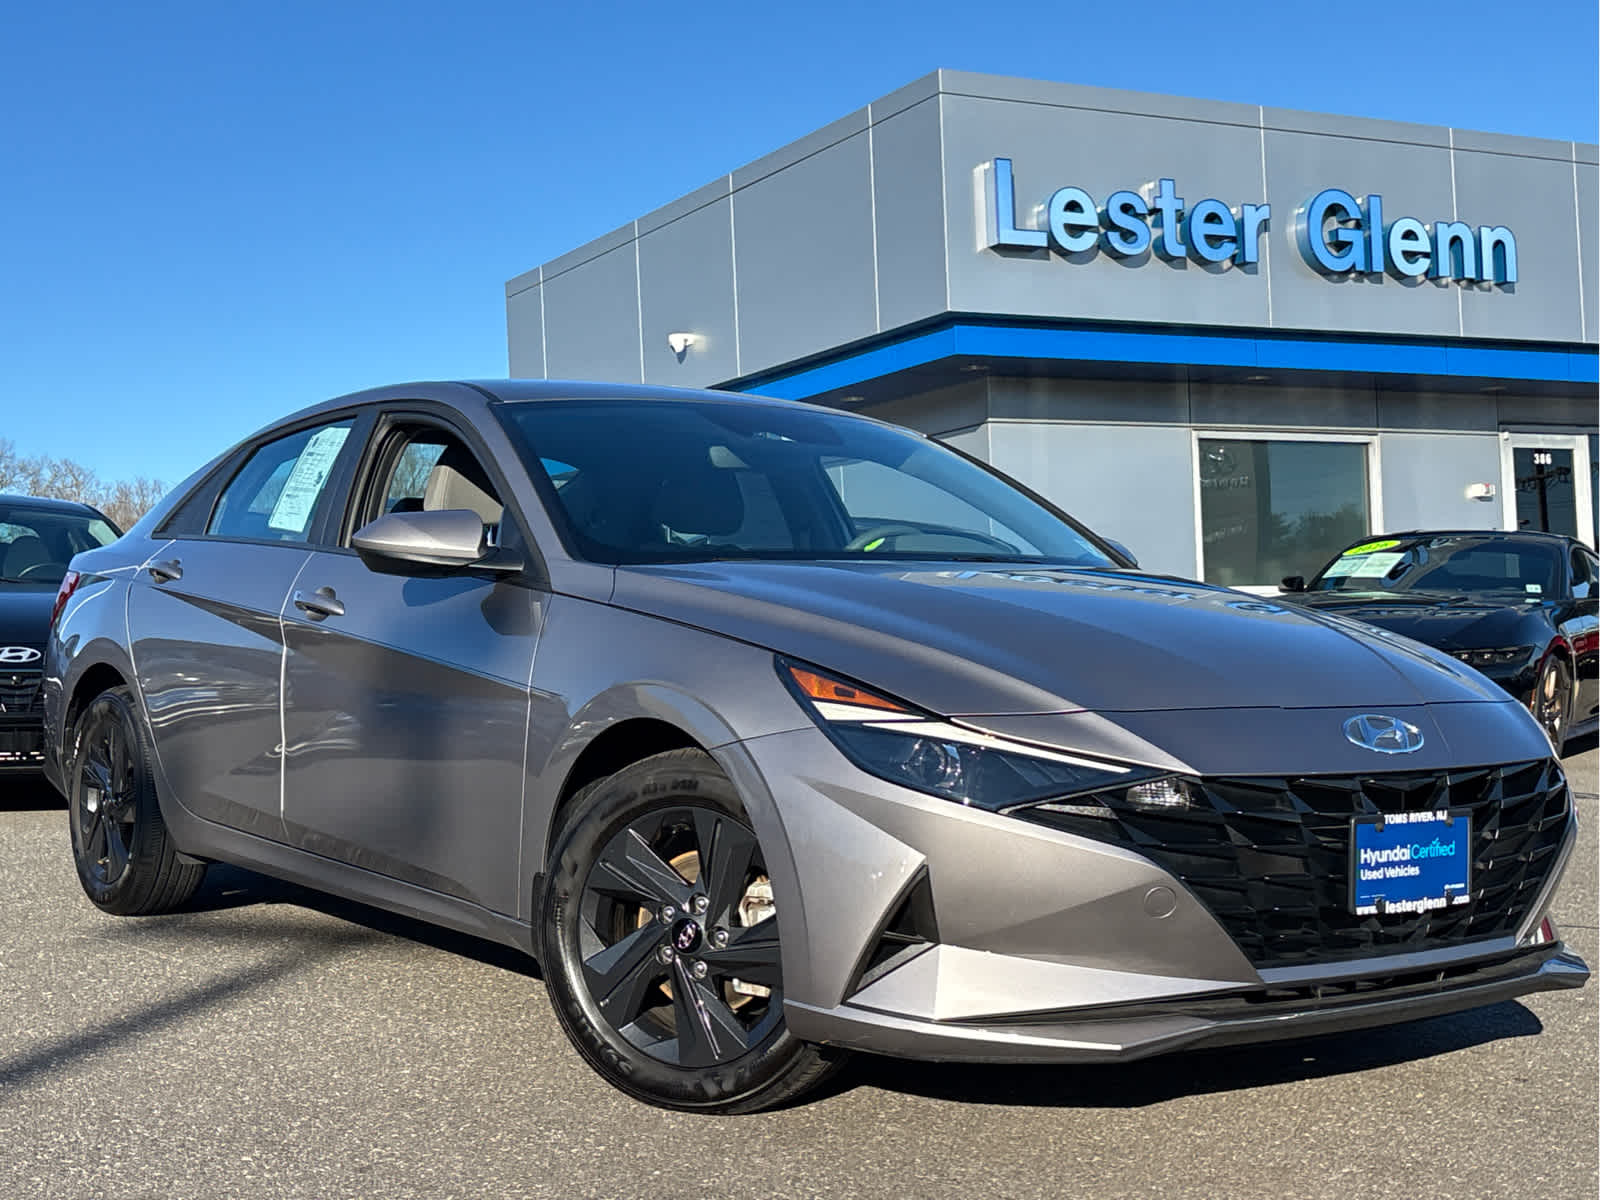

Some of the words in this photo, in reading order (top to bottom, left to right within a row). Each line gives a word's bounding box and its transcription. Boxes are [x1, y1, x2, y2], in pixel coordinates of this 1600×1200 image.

[992, 157, 1271, 265] Lester
[1301, 187, 1518, 285] Glenn
[1384, 813, 1408, 825] TOMS
[1436, 810, 1448, 821] NJ
[1360, 844, 1411, 867] Hyundai
[1411, 837, 1456, 860] Certified
[1360, 867, 1384, 880] Used
[1384, 864, 1420, 878] Vehicles
[1385, 897, 1447, 914] lesterglenn
